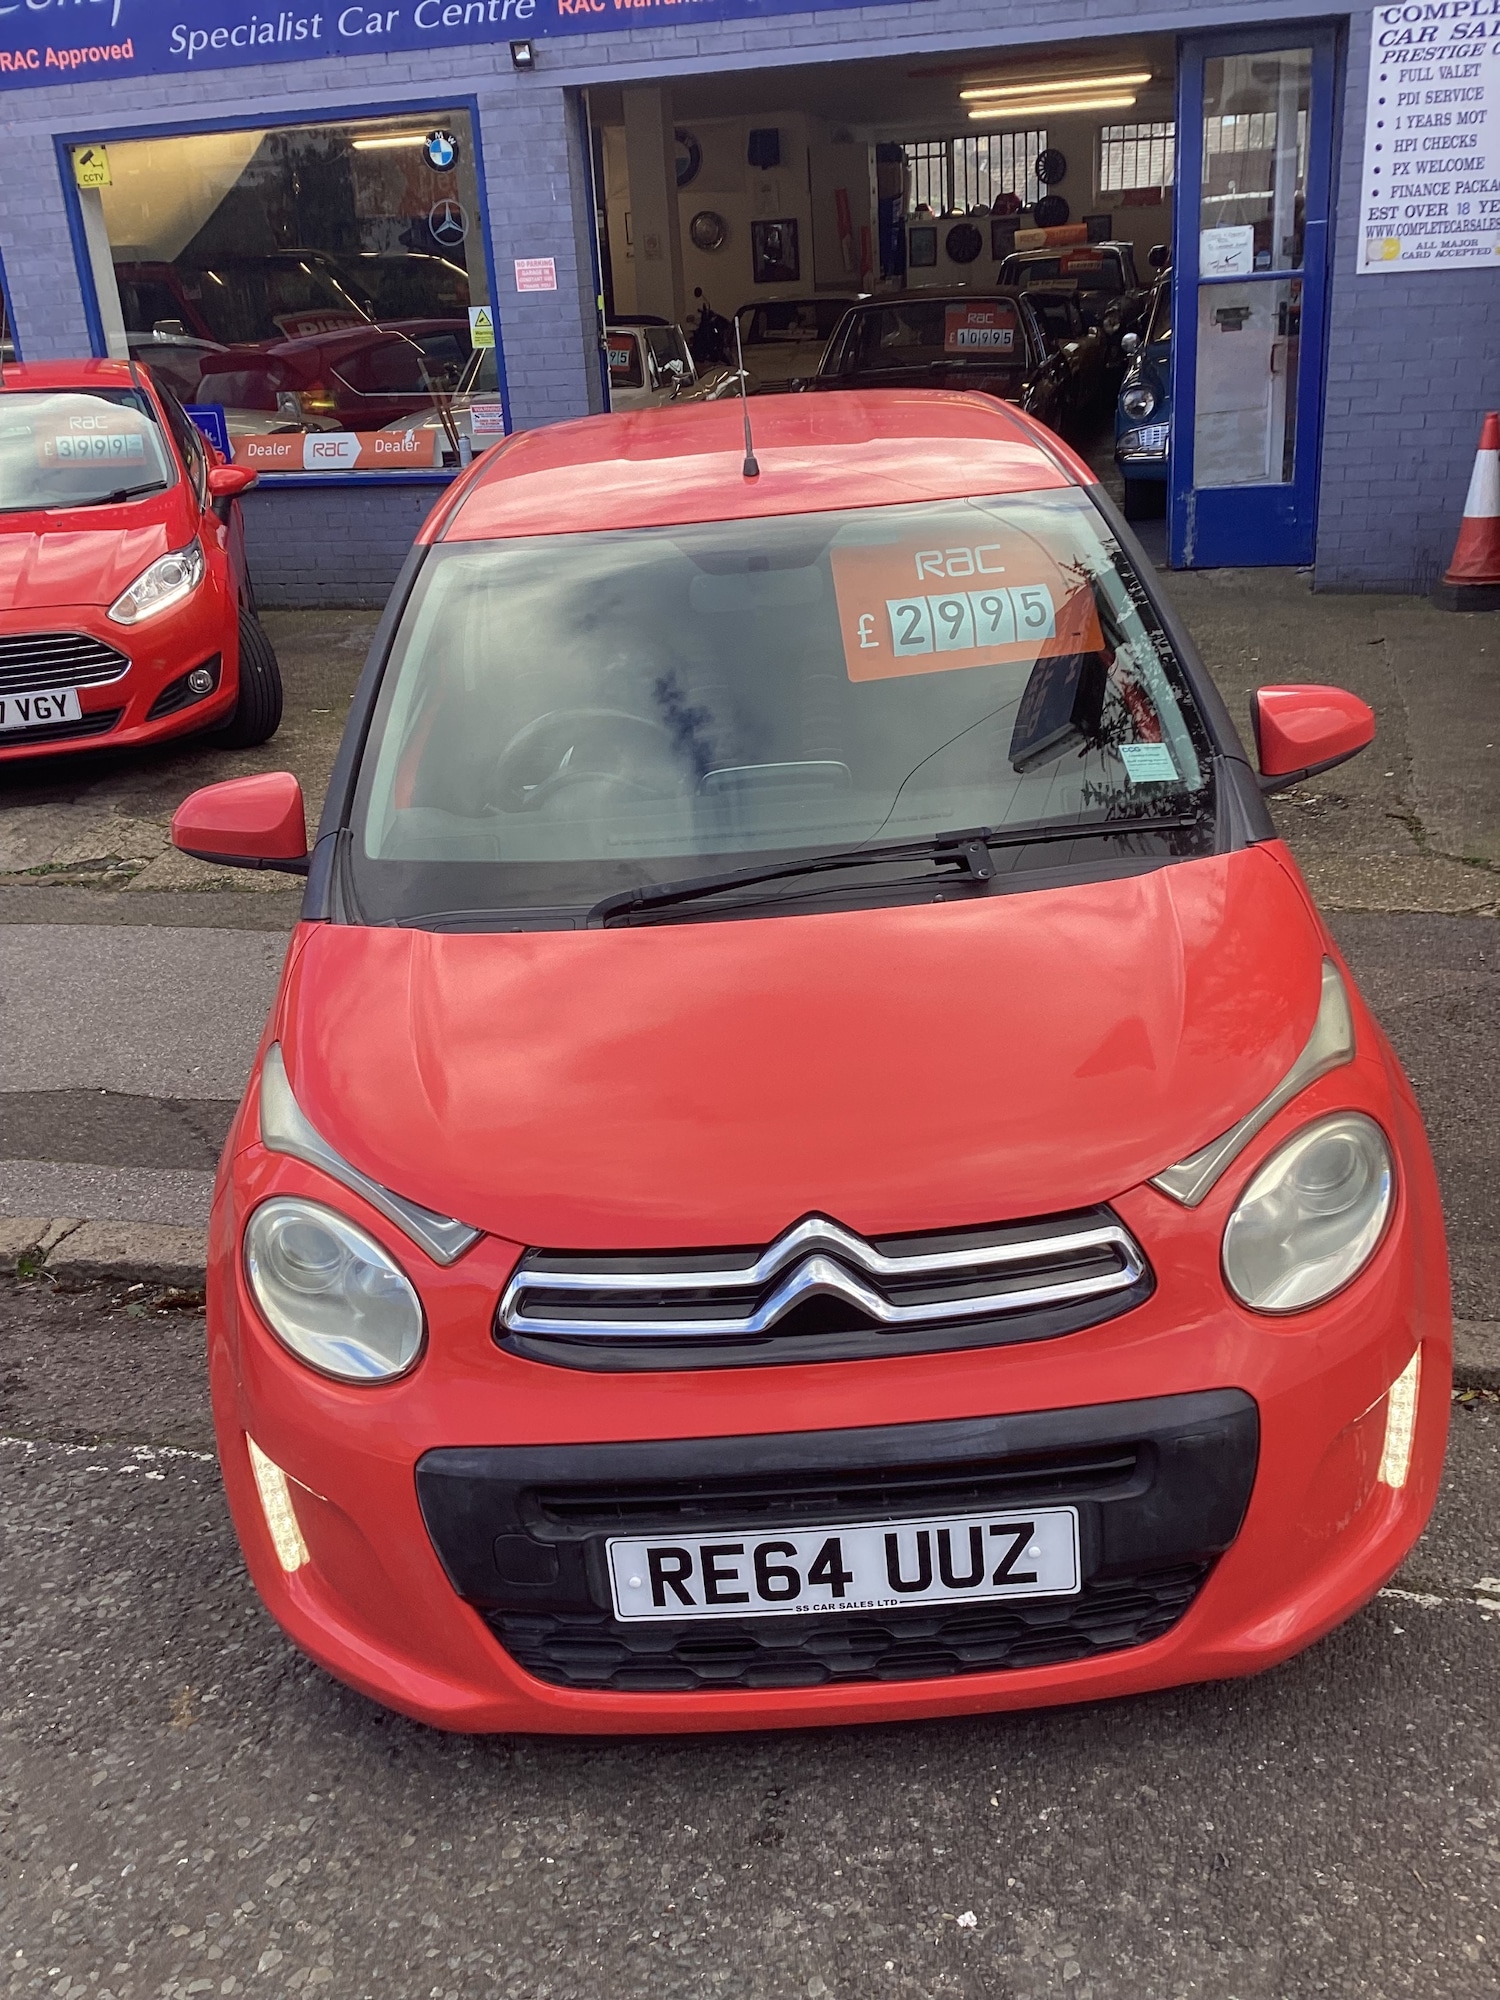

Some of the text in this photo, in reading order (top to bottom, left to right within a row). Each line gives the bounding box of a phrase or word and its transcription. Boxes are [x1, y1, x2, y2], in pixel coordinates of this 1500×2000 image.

[169, 0, 536, 59] Specialist Car Centre
[1379, 26, 1439, 47] CAR
[0, 38, 134, 71] RAC Approved
[1380, 42, 1487, 64] PRESTIGE
[1399, 63, 1482, 83] FULL VALET
[1397, 86, 1485, 106] PDI SERVICE
[1395, 110, 1488, 130] 1 YEARS MOT
[425, 131, 456, 147] BMW
[1393, 134, 1478, 153] HPI CHECKS
[1391, 156, 1486, 176] PX WELCOME
[83, 173, 104, 182] CCTV
[1390, 179, 1500, 199] FINANCE PACKA
[1367, 206, 1399, 221] EST
[1405, 203, 1449, 218] OVER
[1457, 201, 1471, 215] 18
[1402, 247, 1492, 260] CARD ACCEPTED
[1416, 239, 1479, 250] ALL MAJOR
[527, 259, 553, 267] PARKING
[968, 313, 994, 324] RAC
[949, 332, 1011, 345] £ 10995
[69, 416, 109, 430] RAC
[44, 438, 123, 457] £ 3999
[248, 439, 420, 457] Dealer RAC Dealer
[915, 544, 1005, 580] RAC
[857, 592, 1047, 648] £ 2995
[15, 694, 67, 721] VGY
[647, 1521, 1038, 1606] RE64 UUZ
[813, 1603, 835, 1611] CAR
[839, 1600, 874, 1610] SALES
[877, 1598, 898, 1607] LTD
